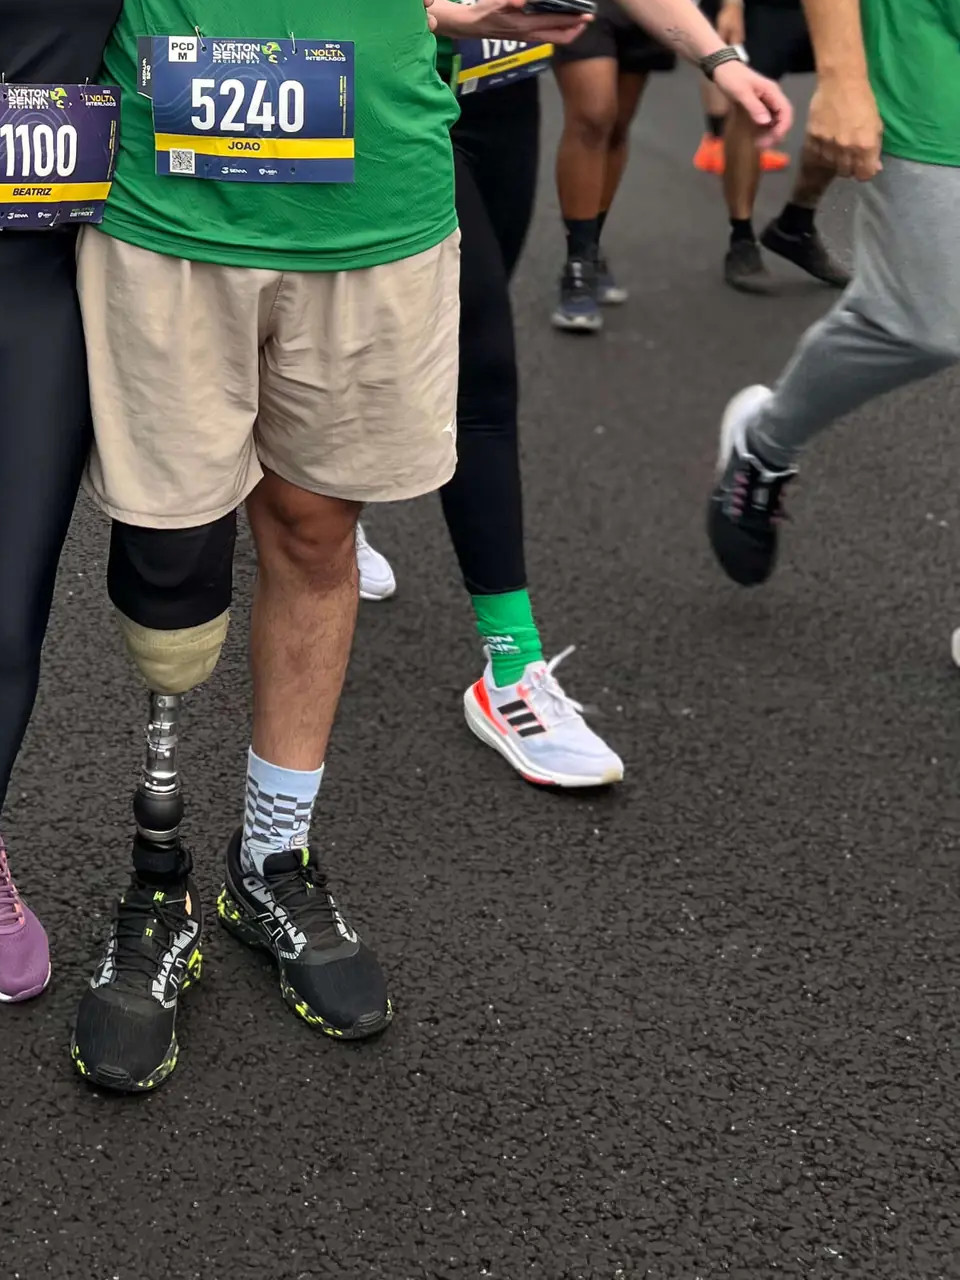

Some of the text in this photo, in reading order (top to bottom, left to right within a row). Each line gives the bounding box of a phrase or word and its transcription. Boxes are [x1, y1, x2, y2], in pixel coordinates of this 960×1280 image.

[171, 42, 195, 51] PCD
[212, 42, 260, 52] AYRTON
[178, 52, 188, 61] M
[212, 51, 260, 60] SENNA
[310, 48, 345, 57] VOLTA
[8, 88, 50, 98] AYRTON
[8, 96, 49, 106] SENNA
[191, 78, 305, 133] 5240
[0, 124, 78, 177] 1100
[227, 141, 261, 151] JOAO
[12, 187, 52, 197] BEATRIZ
